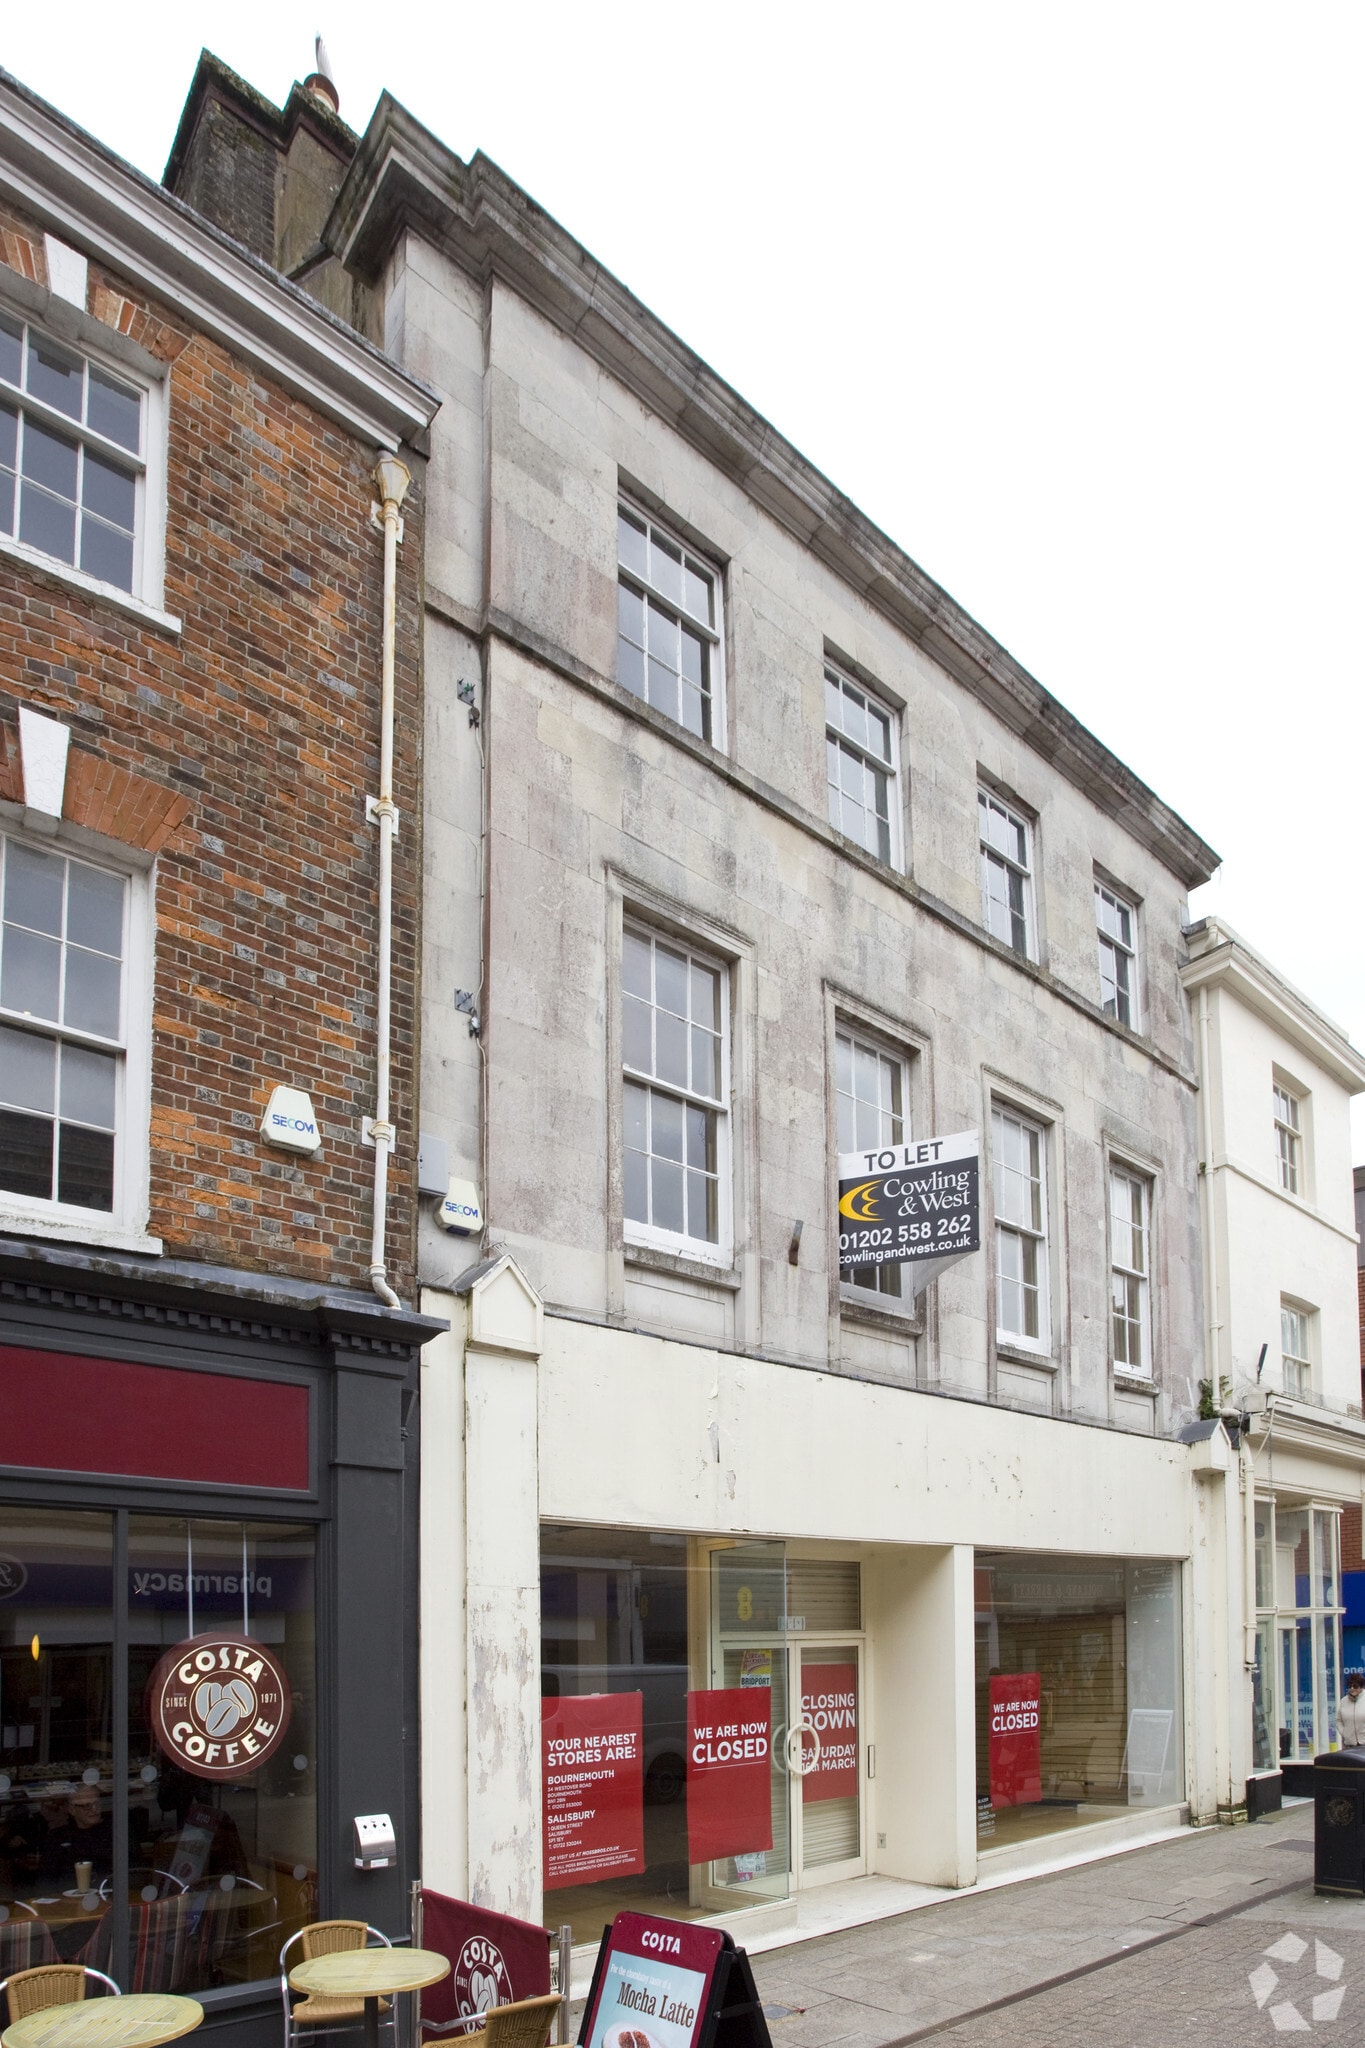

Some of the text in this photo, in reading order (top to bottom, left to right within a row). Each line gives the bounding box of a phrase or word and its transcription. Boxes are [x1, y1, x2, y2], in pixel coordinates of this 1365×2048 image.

[272, 1113, 314, 1135] SECOM
[863, 1141, 943, 1172] TO LET
[883, 1170, 970, 1198] Cowling
[445, 1201, 479, 1218] SECOM
[897, 1189, 971, 1217] & West
[839, 1214, 971, 1250] 01202 558 262
[839, 1234, 971, 1264] cowlingandwest.co.uk
[179, 1647, 264, 1685] COSTA
[741, 1677, 770, 1686] BRIDPORT
[165, 1696, 187, 1708] SINCE
[261, 1693, 277, 1704] 1971
[801, 1693, 855, 1710] CLOSING
[993, 1700, 1038, 1714] WE ARE NOW
[801, 1709, 856, 1732] DOWN
[992, 1712, 1039, 1732] CLOSED
[172, 1717, 275, 1763] COFFEE
[693, 1722, 768, 1740] WE ARE NOW
[548, 1733, 637, 1752] YOUR NEAREST
[692, 1737, 768, 1764] CLOSED
[547, 1746, 636, 1766] STORES ARE:
[821, 1757, 856, 1771] MARCH
[547, 1769, 615, 1785] BOURNEMOUTH
[547, 1790, 582, 1798] BOURNEMOUTH
[547, 1809, 596, 1824] SALISBURY
[548, 1829, 572, 1837] SALISBURY
[557, 1853, 568, 1861] VISIT
[641, 1930, 680, 1954] COSTA
[463, 1941, 504, 1983] COSTA
[616, 1981, 695, 2028] Mocha Latte
